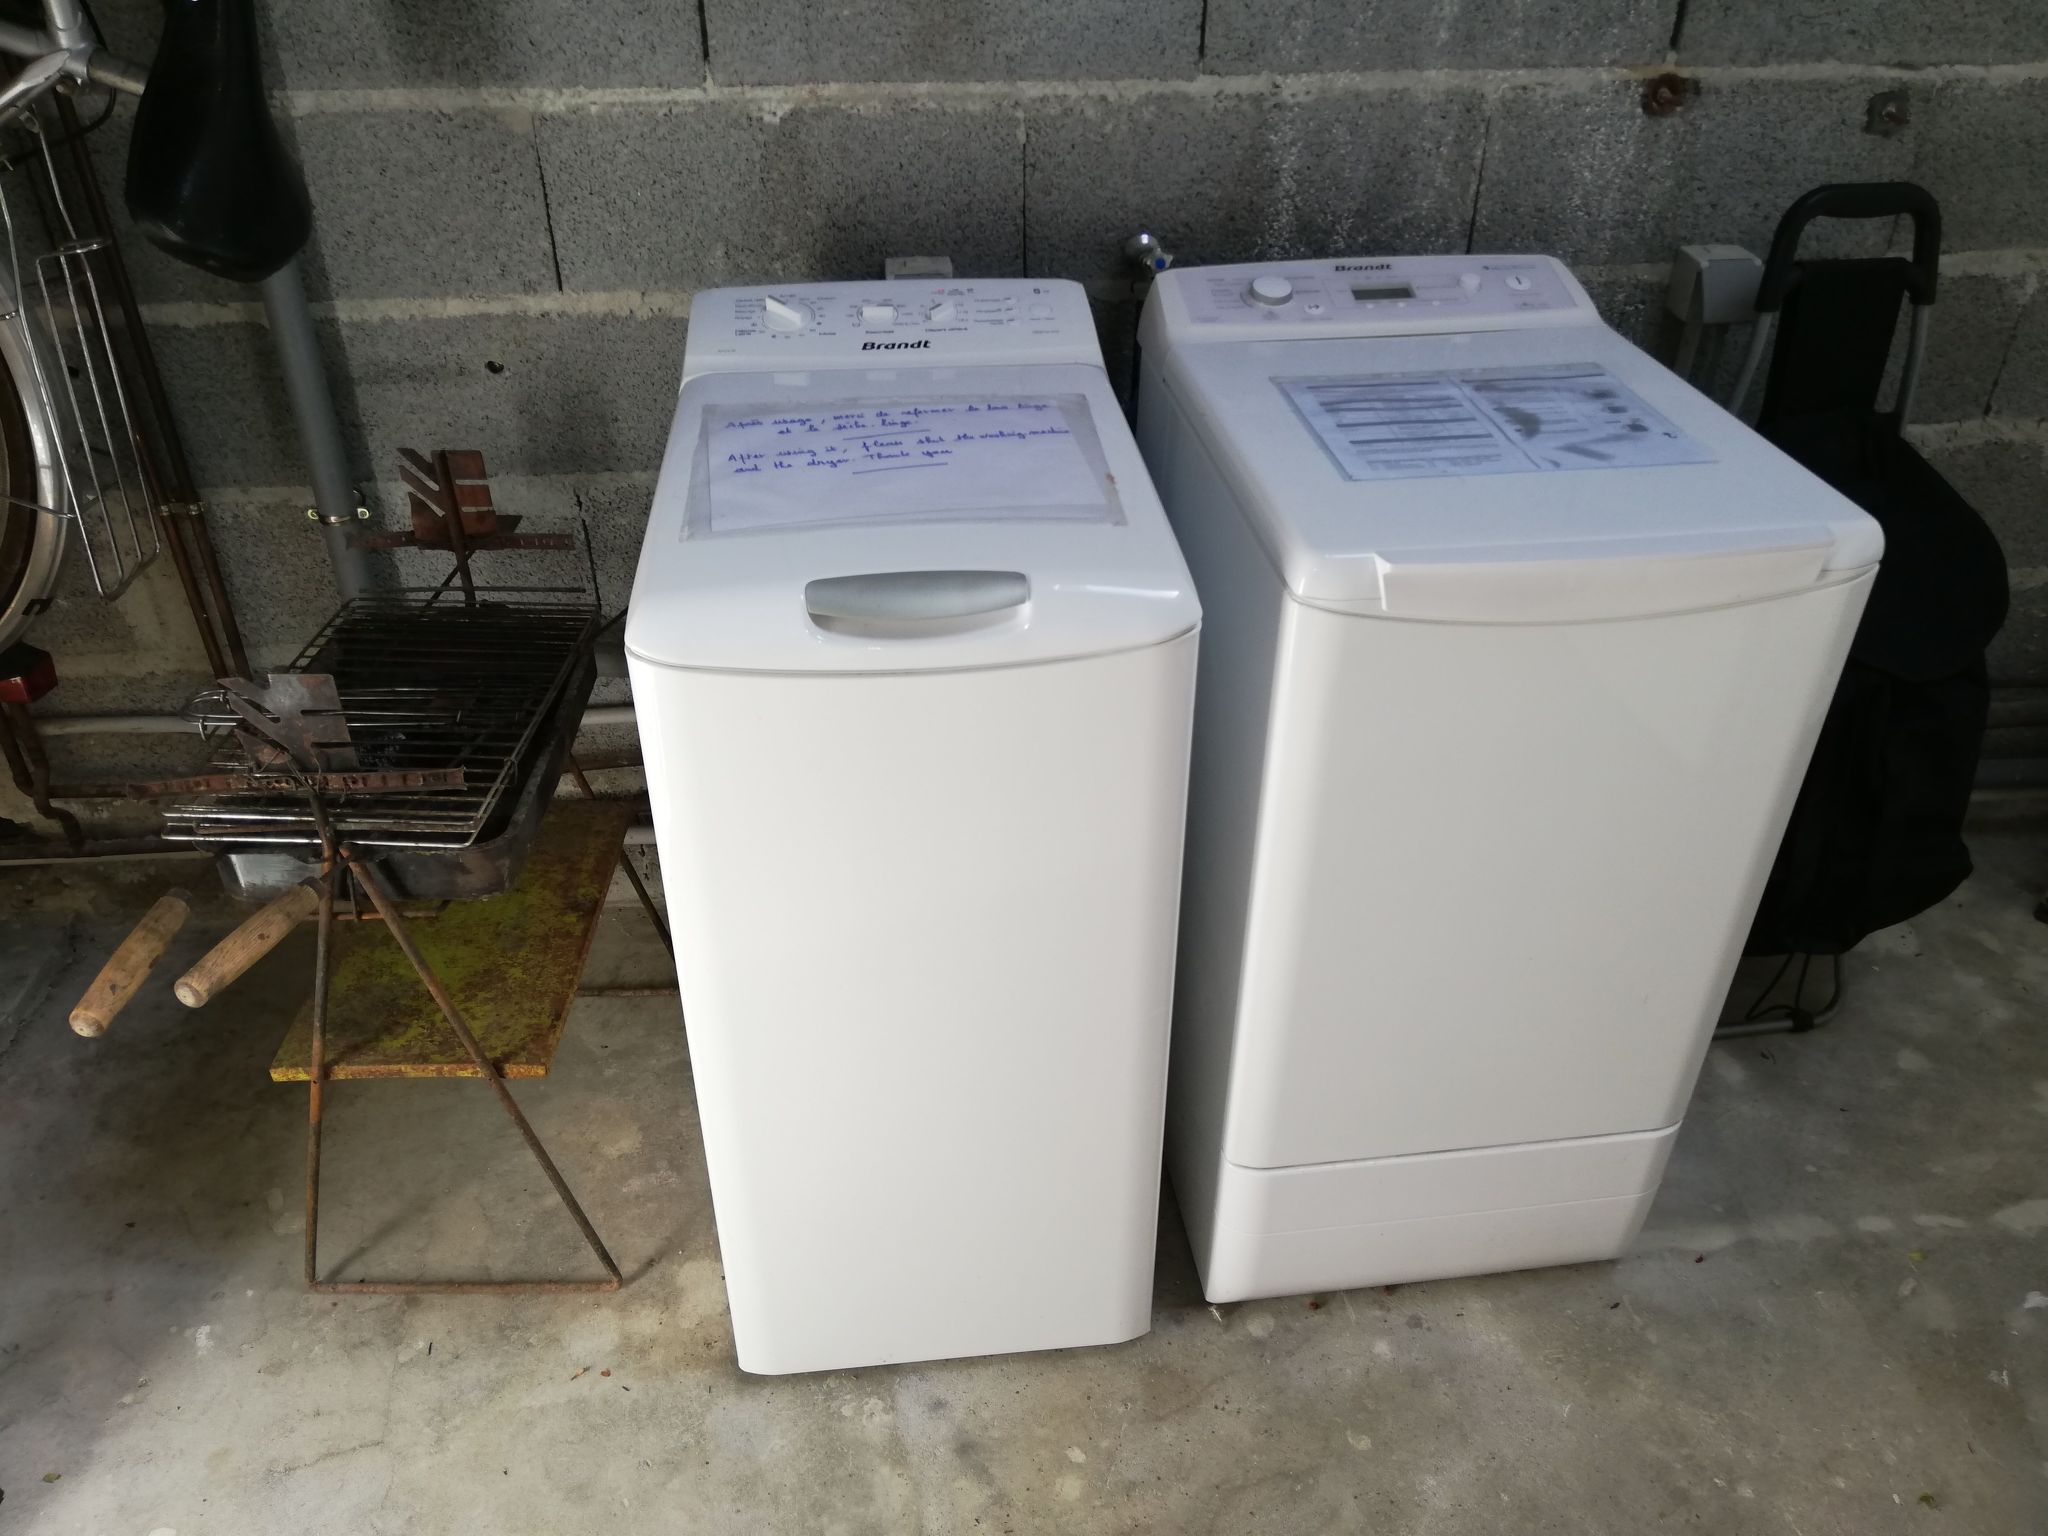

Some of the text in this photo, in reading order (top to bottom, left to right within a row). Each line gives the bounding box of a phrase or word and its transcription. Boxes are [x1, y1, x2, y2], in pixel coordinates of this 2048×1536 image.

[1335, 264, 1391, 272] Brandt
[861, 340, 932, 351] Brandt
[728, 453, 765, 465] After
